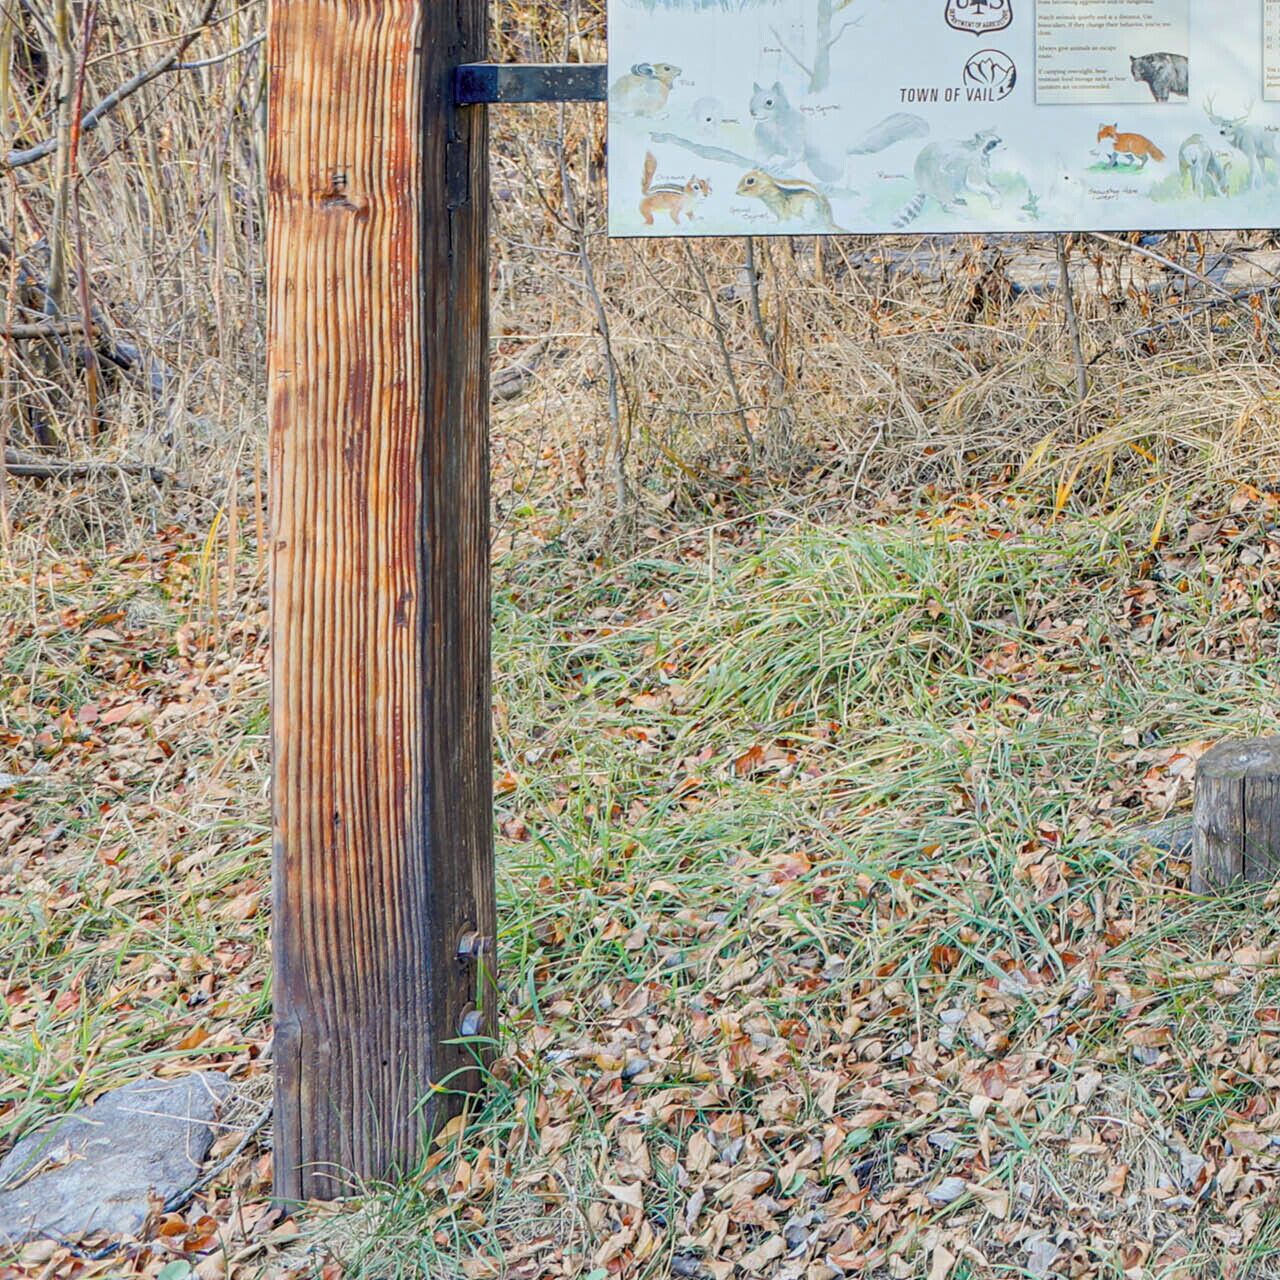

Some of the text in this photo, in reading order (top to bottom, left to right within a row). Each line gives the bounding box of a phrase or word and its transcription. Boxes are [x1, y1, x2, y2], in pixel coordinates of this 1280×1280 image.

[899, 87, 995, 104] TOWN OF VAIL
